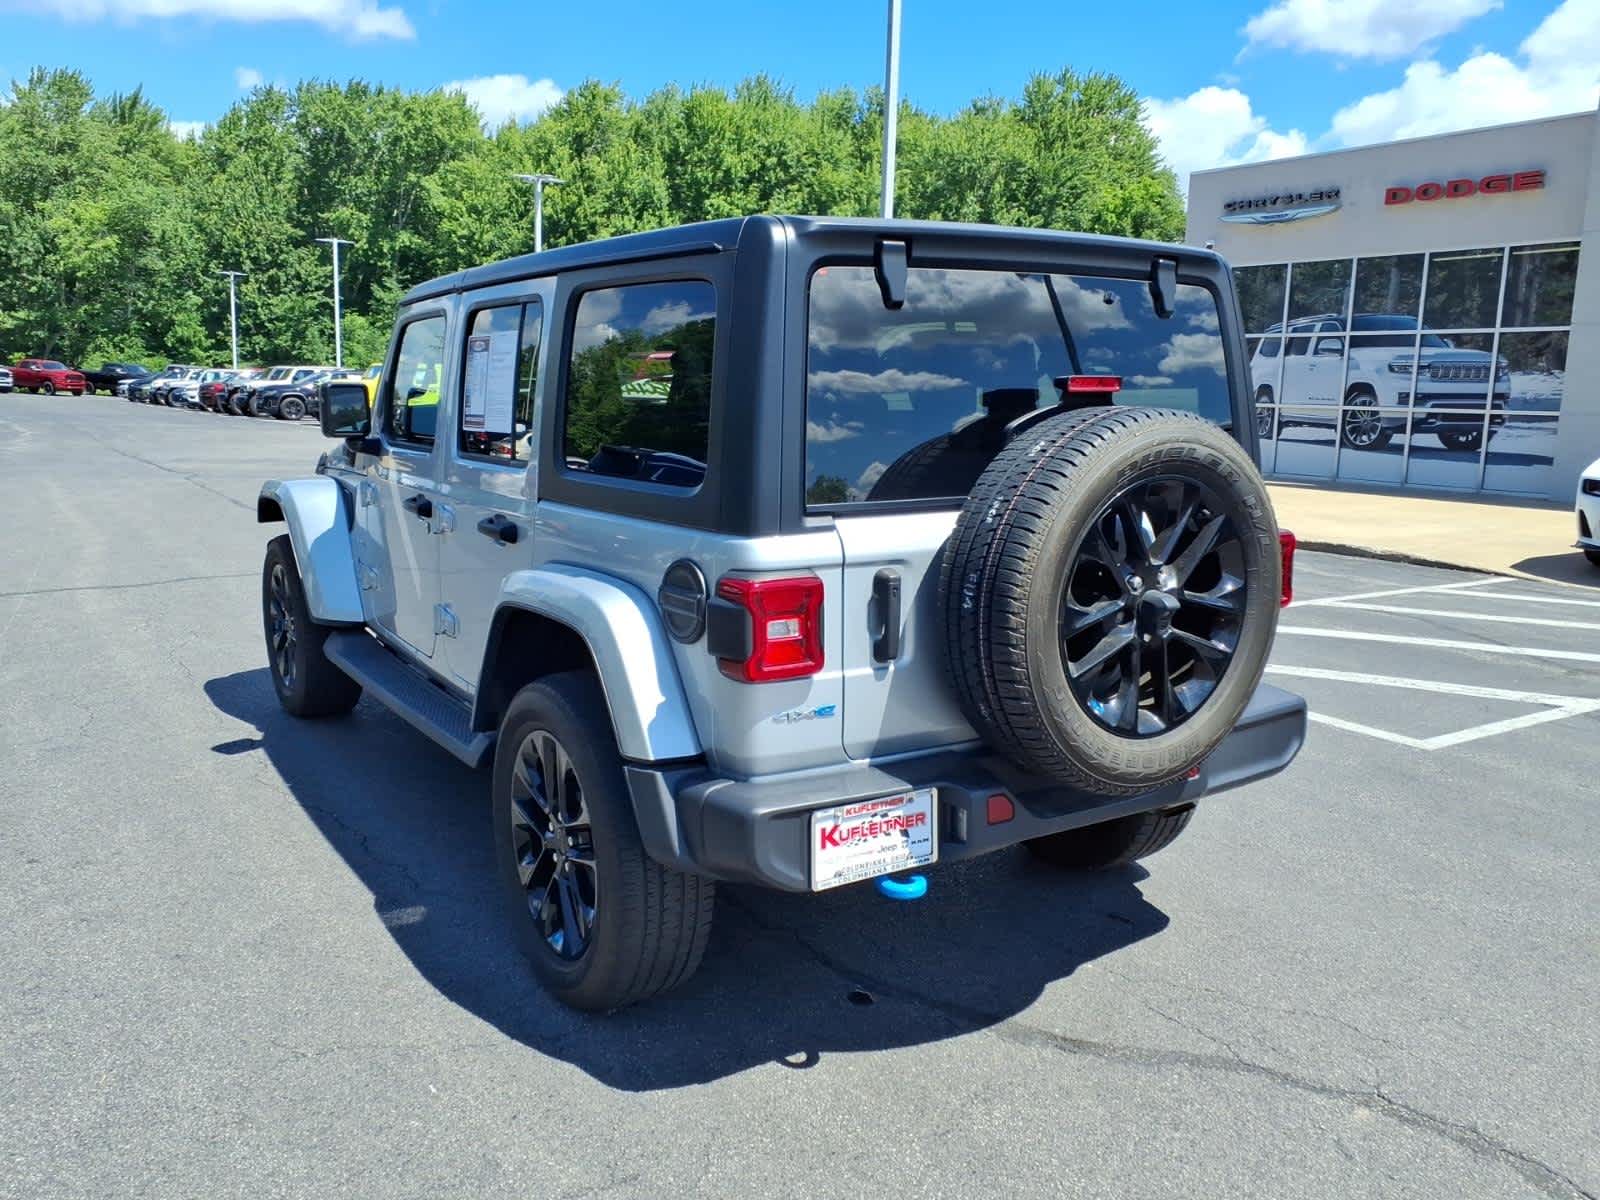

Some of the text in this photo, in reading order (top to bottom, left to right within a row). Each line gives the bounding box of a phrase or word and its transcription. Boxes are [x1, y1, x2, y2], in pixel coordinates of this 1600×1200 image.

[1223, 187, 1341, 212] CHRYSLER
[1384, 170, 1545, 205] DODGE
[1118, 446, 1241, 483] DUELER
[845, 796, 905, 816] KUFLEITNER
[820, 812, 927, 851] KUFLEITNER
